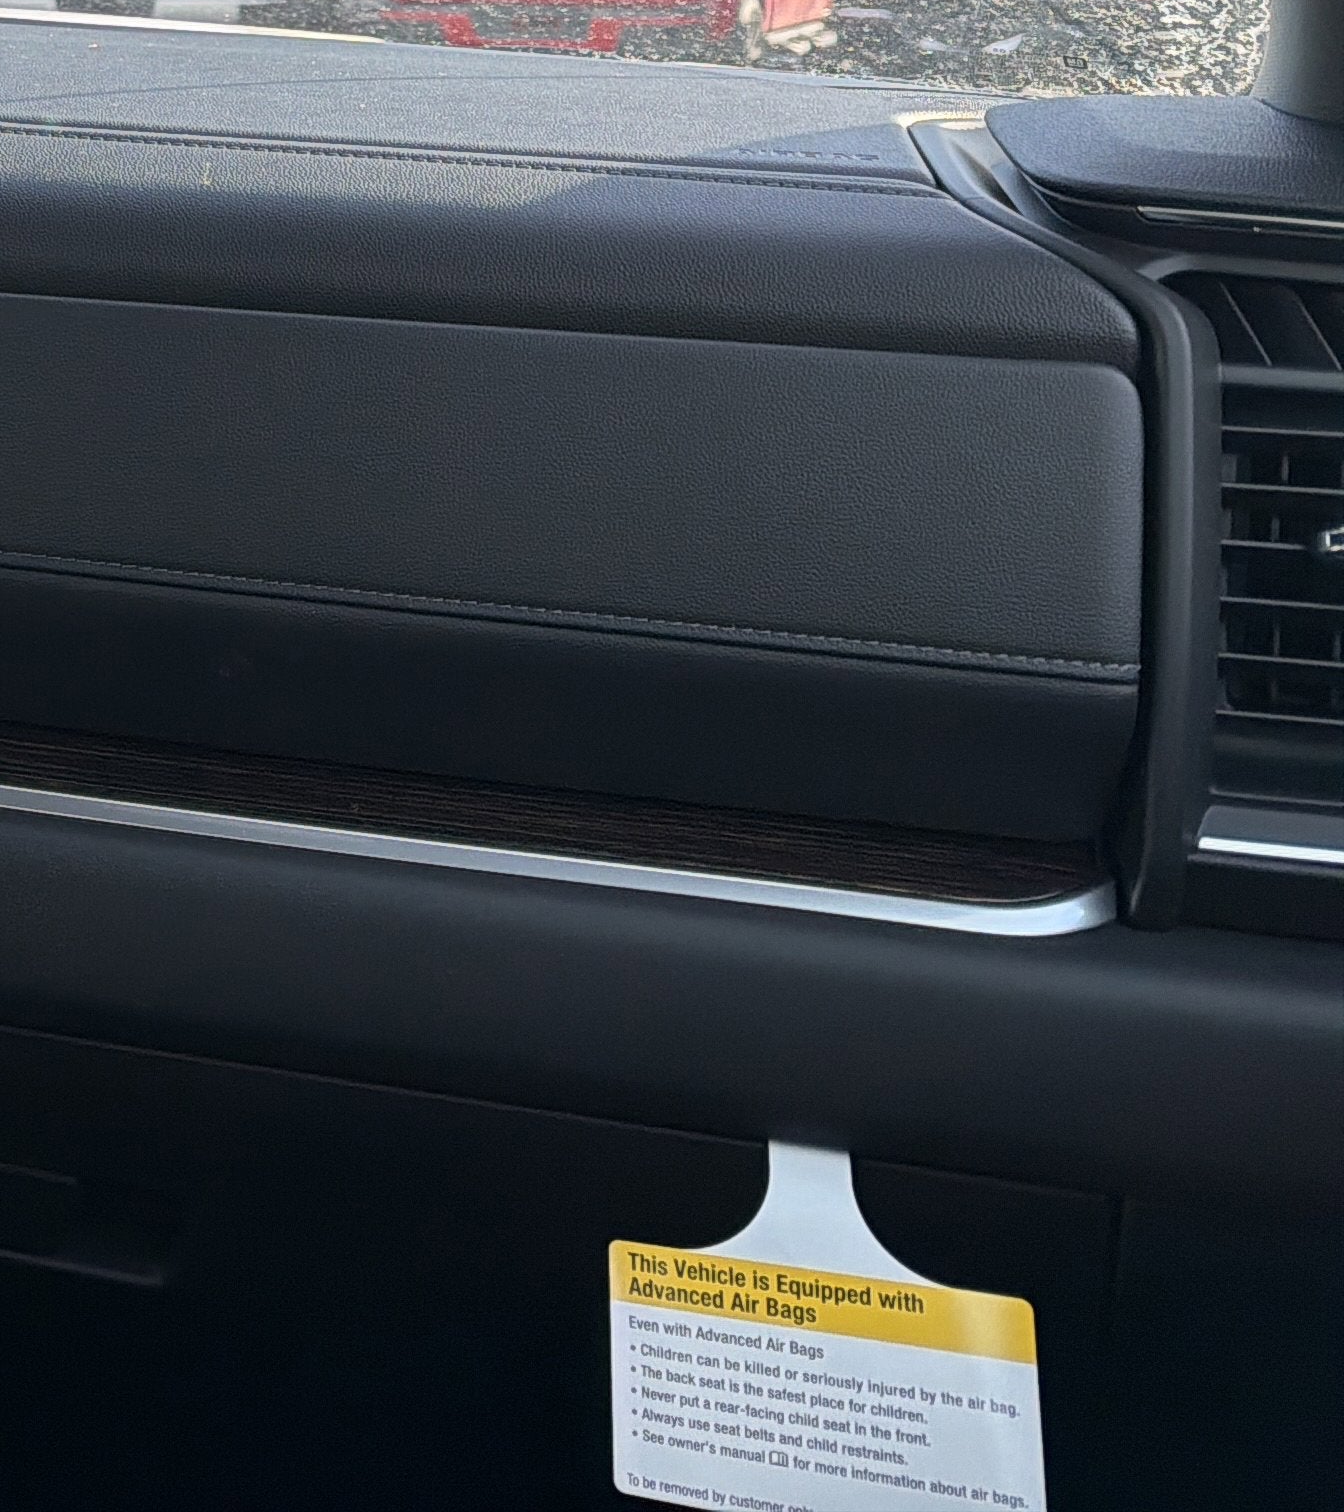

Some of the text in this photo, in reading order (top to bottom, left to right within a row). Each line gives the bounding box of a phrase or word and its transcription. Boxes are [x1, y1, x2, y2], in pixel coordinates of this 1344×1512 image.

[628, 1252, 925, 1314] This Vehicle is Equipped with
[629, 1277, 817, 1326] Advanced Air Bags
[628, 1315, 825, 1360] Even with Advanced Air Bags
[640, 1344, 1021, 1419] Children can be killed or seriously injured by the air bag.
[641, 1364, 929, 1425] The back seat is the safest place for children.
[641, 1386, 932, 1447] Never put a rear-facing child seat in the front.
[642, 1408, 909, 1466] Always use seat belts and child restraints.
[627, 1472, 639, 1487] To
[642, 1476, 656, 1489] be
[659, 1482, 708, 1501] removed
[712, 1491, 726, 1506] by
[729, 1495, 785, 1512] customer
[642, 1429, 1029, 1510] See owner's manual for more information about air bags.
